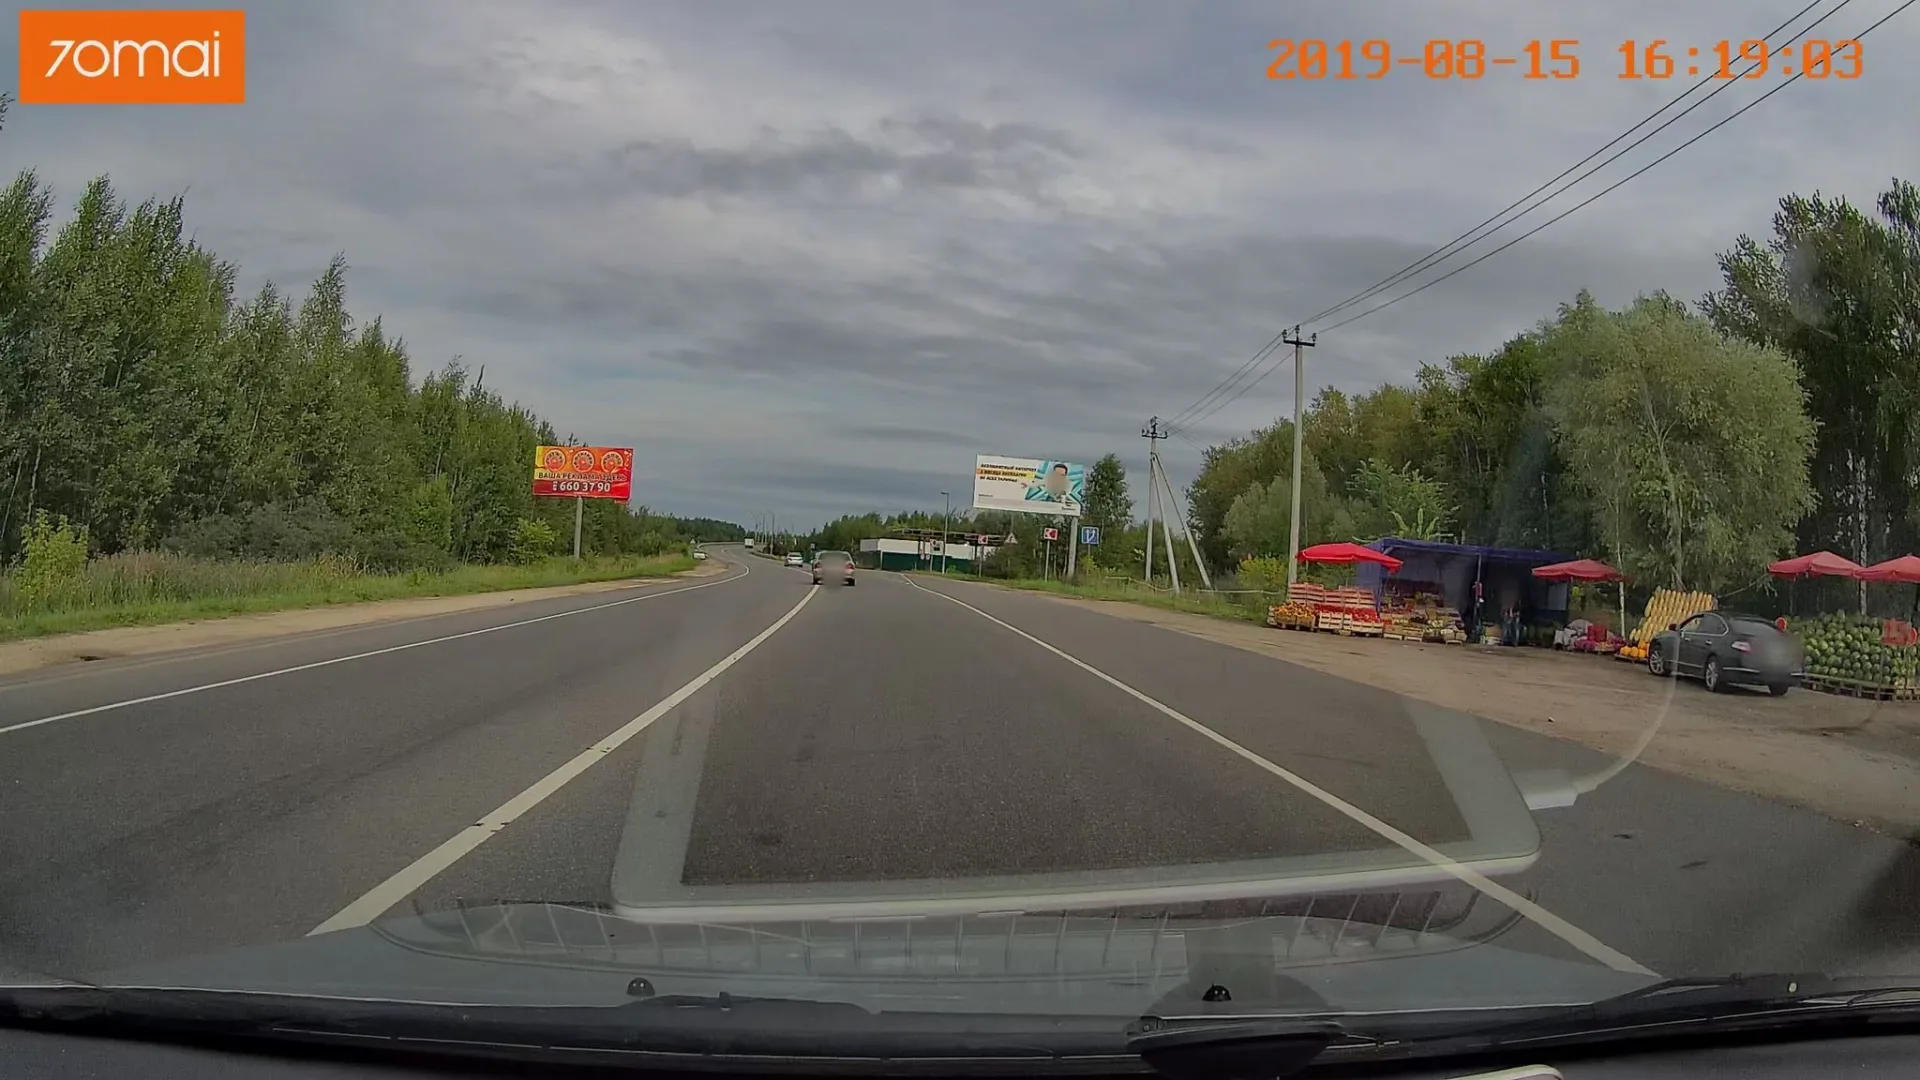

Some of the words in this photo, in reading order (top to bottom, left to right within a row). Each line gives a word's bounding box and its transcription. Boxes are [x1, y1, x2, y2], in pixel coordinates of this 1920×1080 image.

[559, 481, 579, 491] 660
[582, 482, 595, 492] 37
[597, 482, 611, 492] 90
